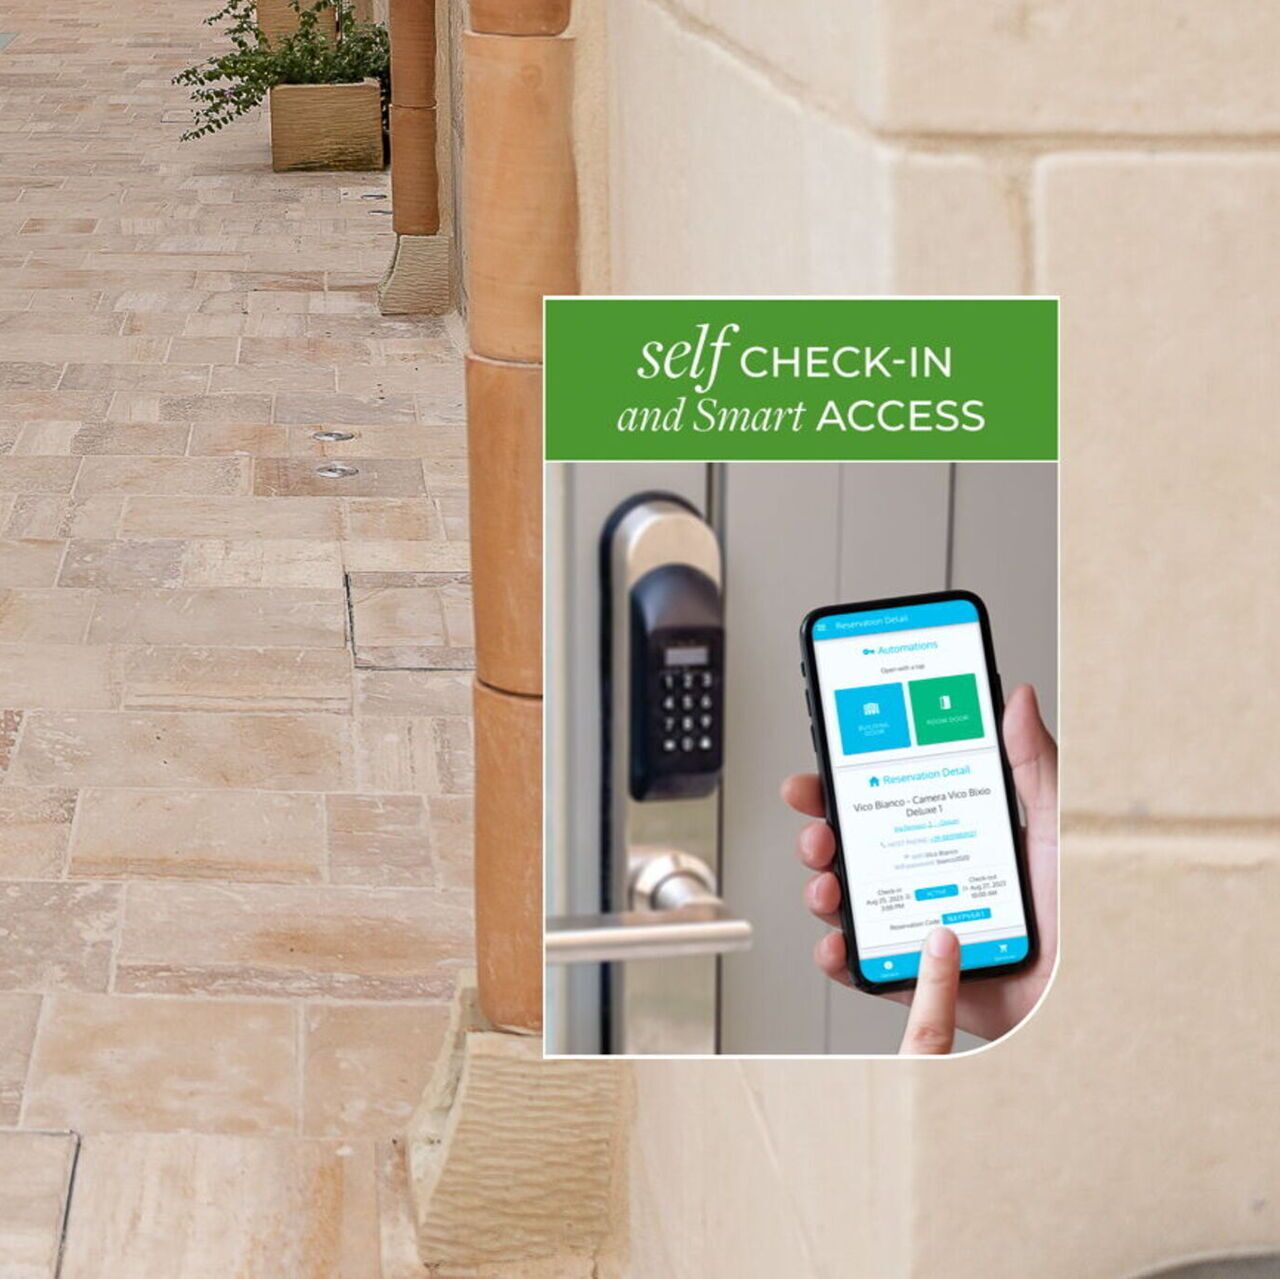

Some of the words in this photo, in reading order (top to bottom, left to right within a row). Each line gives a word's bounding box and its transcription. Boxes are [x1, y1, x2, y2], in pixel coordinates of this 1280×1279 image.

[836, 618, 884, 629] Reservation
[885, 615, 908, 625] Detail
[877, 640, 938, 654] Automations
[883, 770, 940, 784] Reservation
[942, 765, 970, 777] Detail
[853, 802, 873, 812] Vico
[875, 798, 905, 809] Bianco
[913, 793, 946, 805] Camera
[948, 790, 967, 800] Vico
[906, 807, 936, 817] Deluxe
